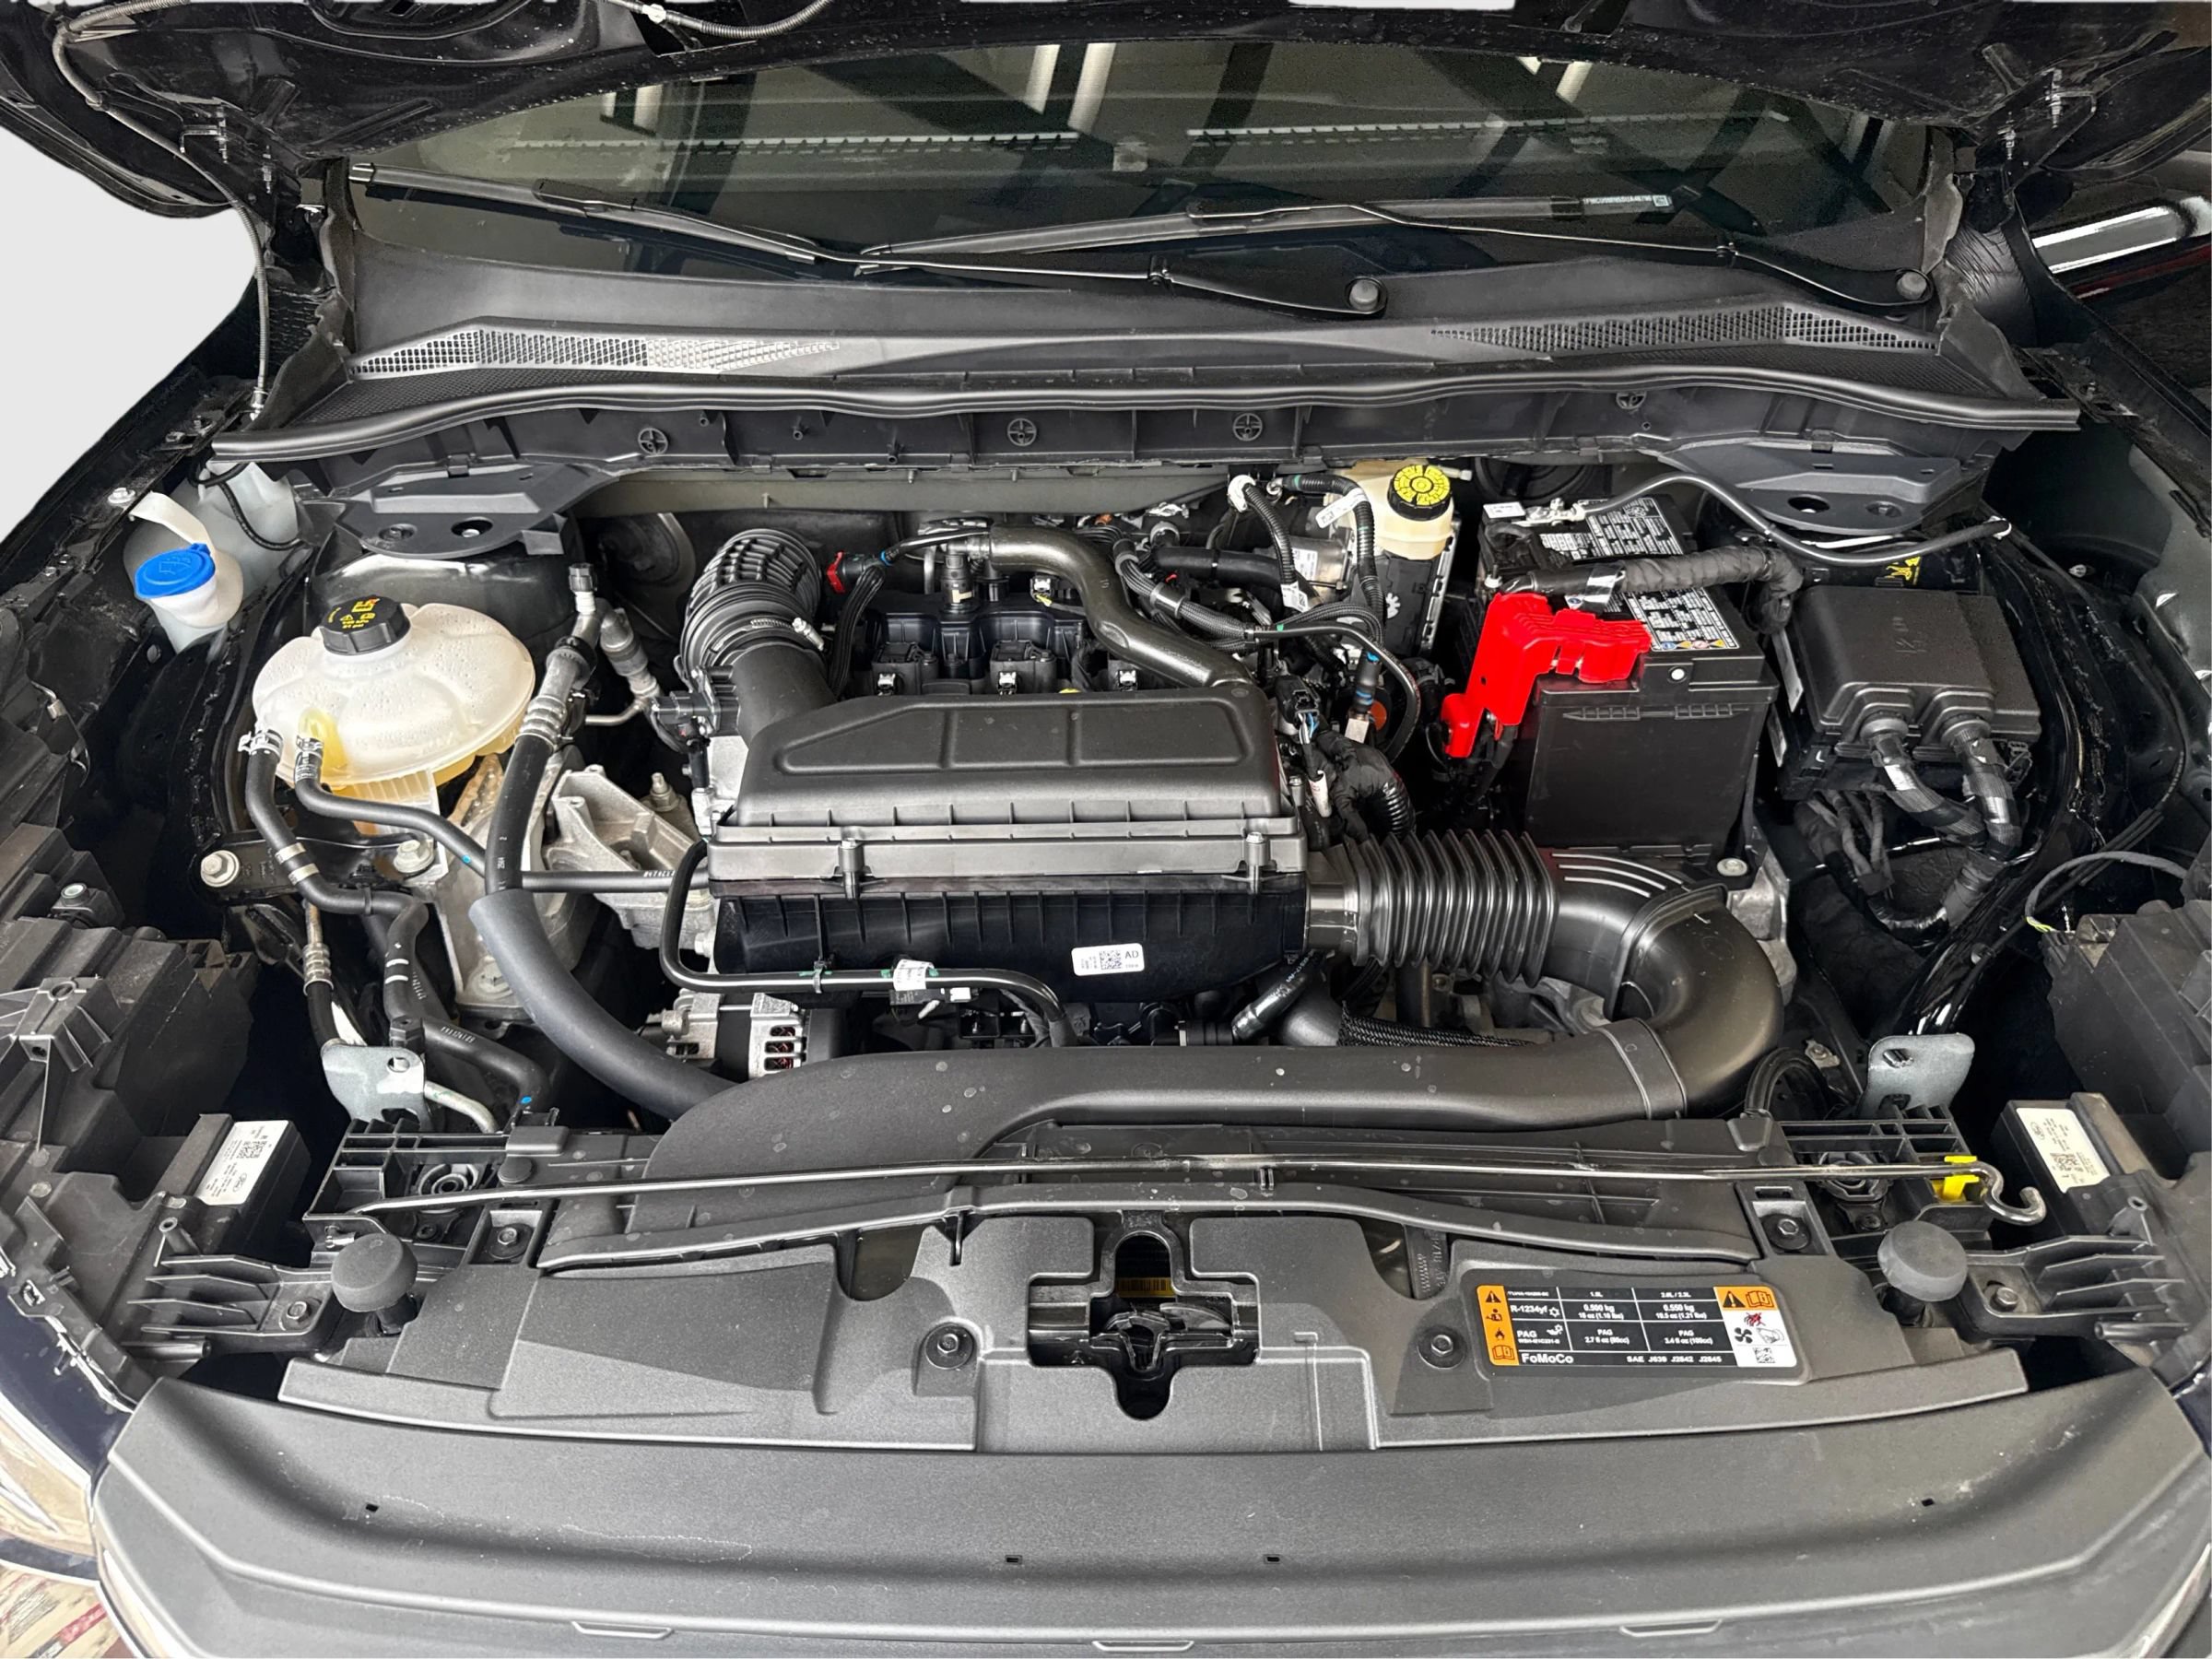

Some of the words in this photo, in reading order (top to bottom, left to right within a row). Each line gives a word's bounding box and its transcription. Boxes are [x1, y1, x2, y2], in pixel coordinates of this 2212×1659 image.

[1124, 950, 1139, 959] AD
[1510, 1305, 1547, 1314] R-1234yf
[1583, 1303, 1604, 1312] 0.500
[1604, 1303, 1615, 1313] kg
[1663, 1303, 1684, 1312] 0.550
[1684, 1303, 1695, 1312] kg
[1516, 1330, 1537, 1338] PAG
[1521, 1353, 1574, 1364] FoMoCo
[1626, 1355, 1645, 1363] SAE
[1648, 1355, 1668, 1363] J639
